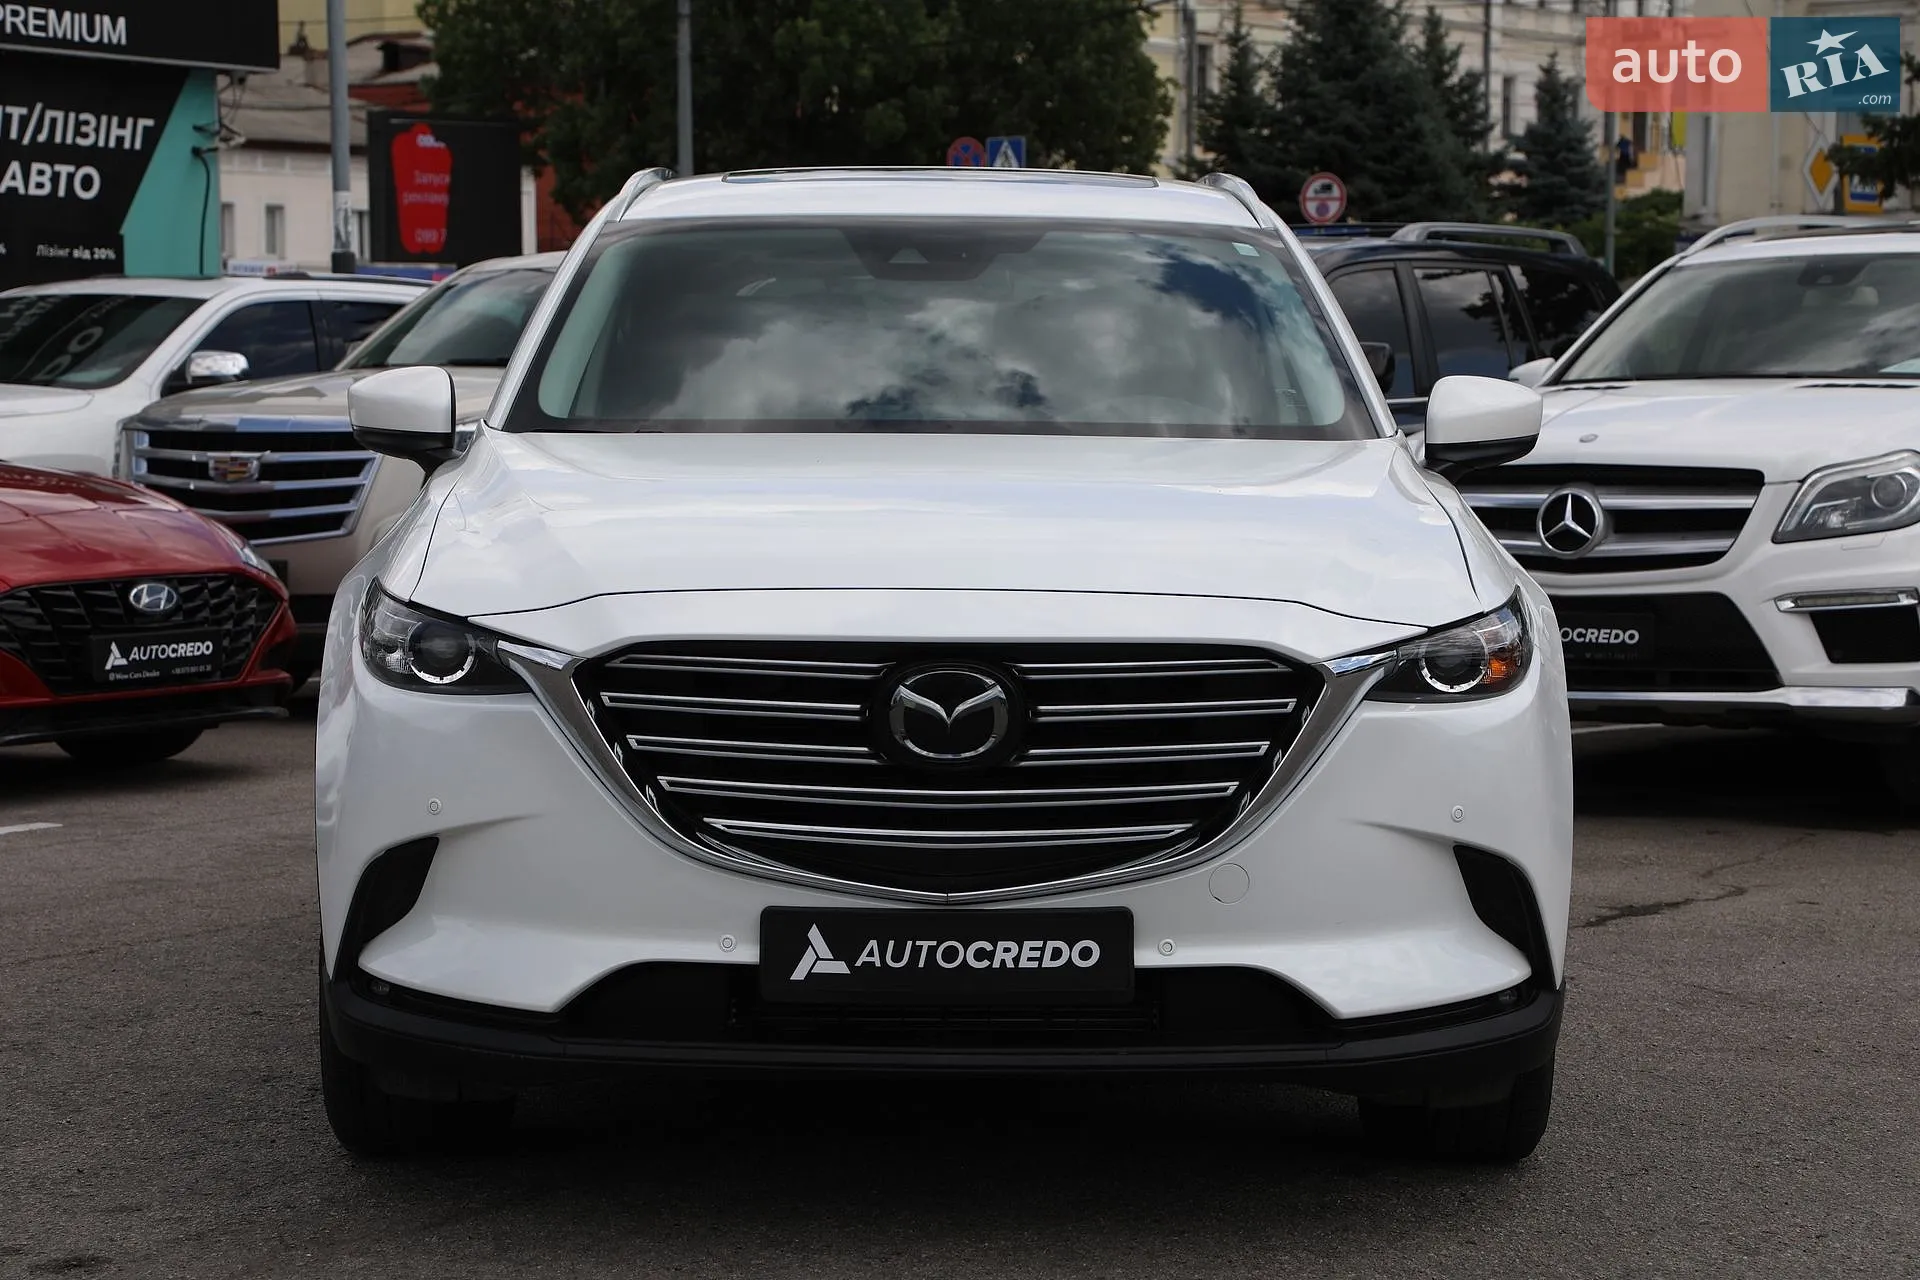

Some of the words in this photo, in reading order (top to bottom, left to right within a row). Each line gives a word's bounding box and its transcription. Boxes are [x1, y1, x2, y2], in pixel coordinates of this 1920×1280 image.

[0, 4, 127, 45] REMIUM
[0, 102, 155, 150] Т/ЛІЗІНГ
[0, 160, 101, 200] АВТО
[129, 641, 213, 661] AUTOCREDO
[1560, 627, 1640, 645] OCREDO
[855, 939, 1100, 968] AUTOCREDO
